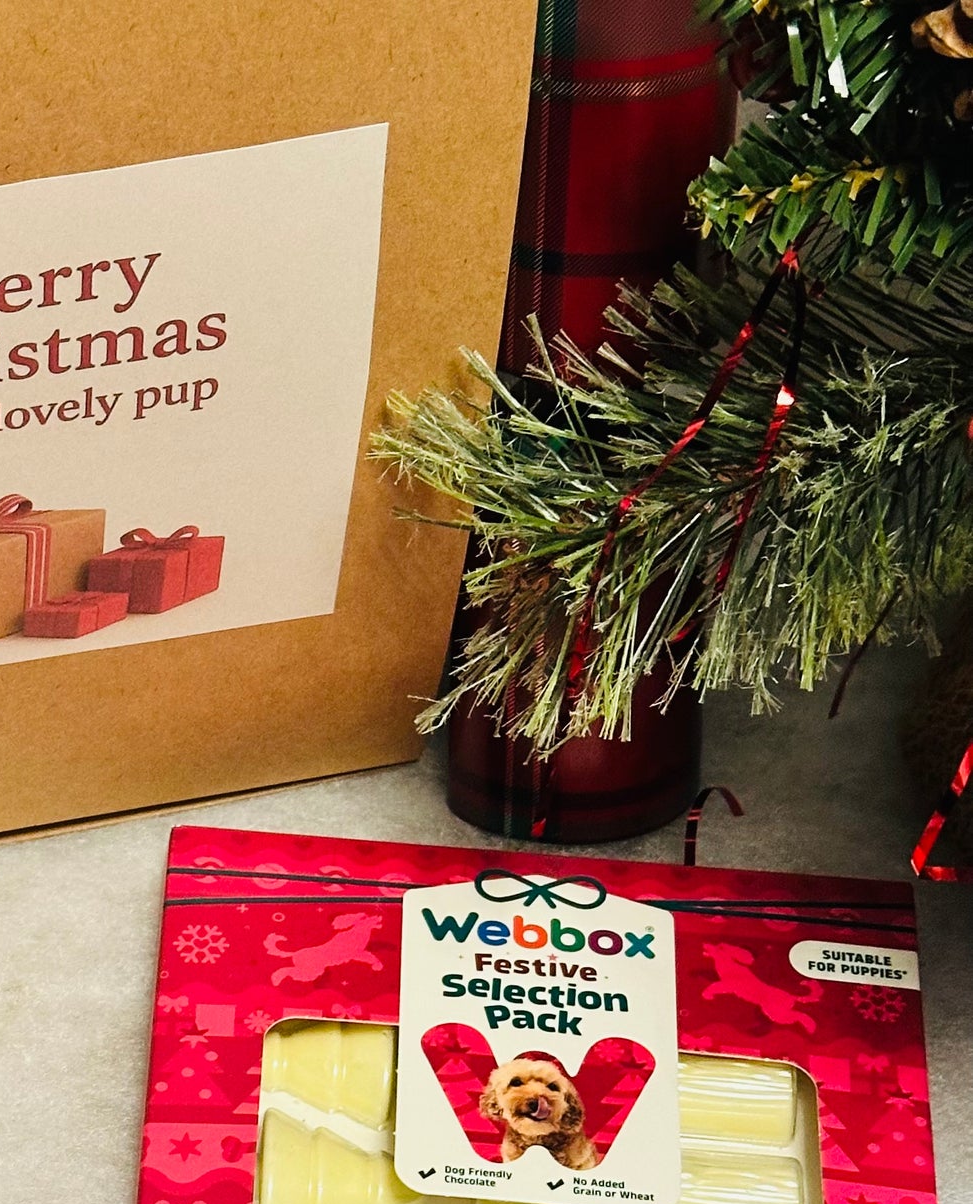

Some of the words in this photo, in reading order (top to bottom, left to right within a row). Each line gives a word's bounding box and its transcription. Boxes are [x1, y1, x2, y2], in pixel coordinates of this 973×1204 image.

[132, 376, 219, 419] pup
[421, 907, 656, 960] Webbox
[822, 950, 892, 966] SUITABLE
[474, 953, 597, 982] Festive
[808, 961, 836, 973] FOR
[441, 973, 629, 1013] Selection
[484, 1005, 582, 1036] Pack
[444, 1165, 465, 1176] Dog
[468, 1168, 513, 1180] Friendly
[444, 1175, 496, 1187] Chocolate
[573, 1177, 587, 1187] No
[590, 1179, 625, 1189] Added
[573, 1187, 602, 1197] Grain
[619, 1191, 655, 1202] Wheat
